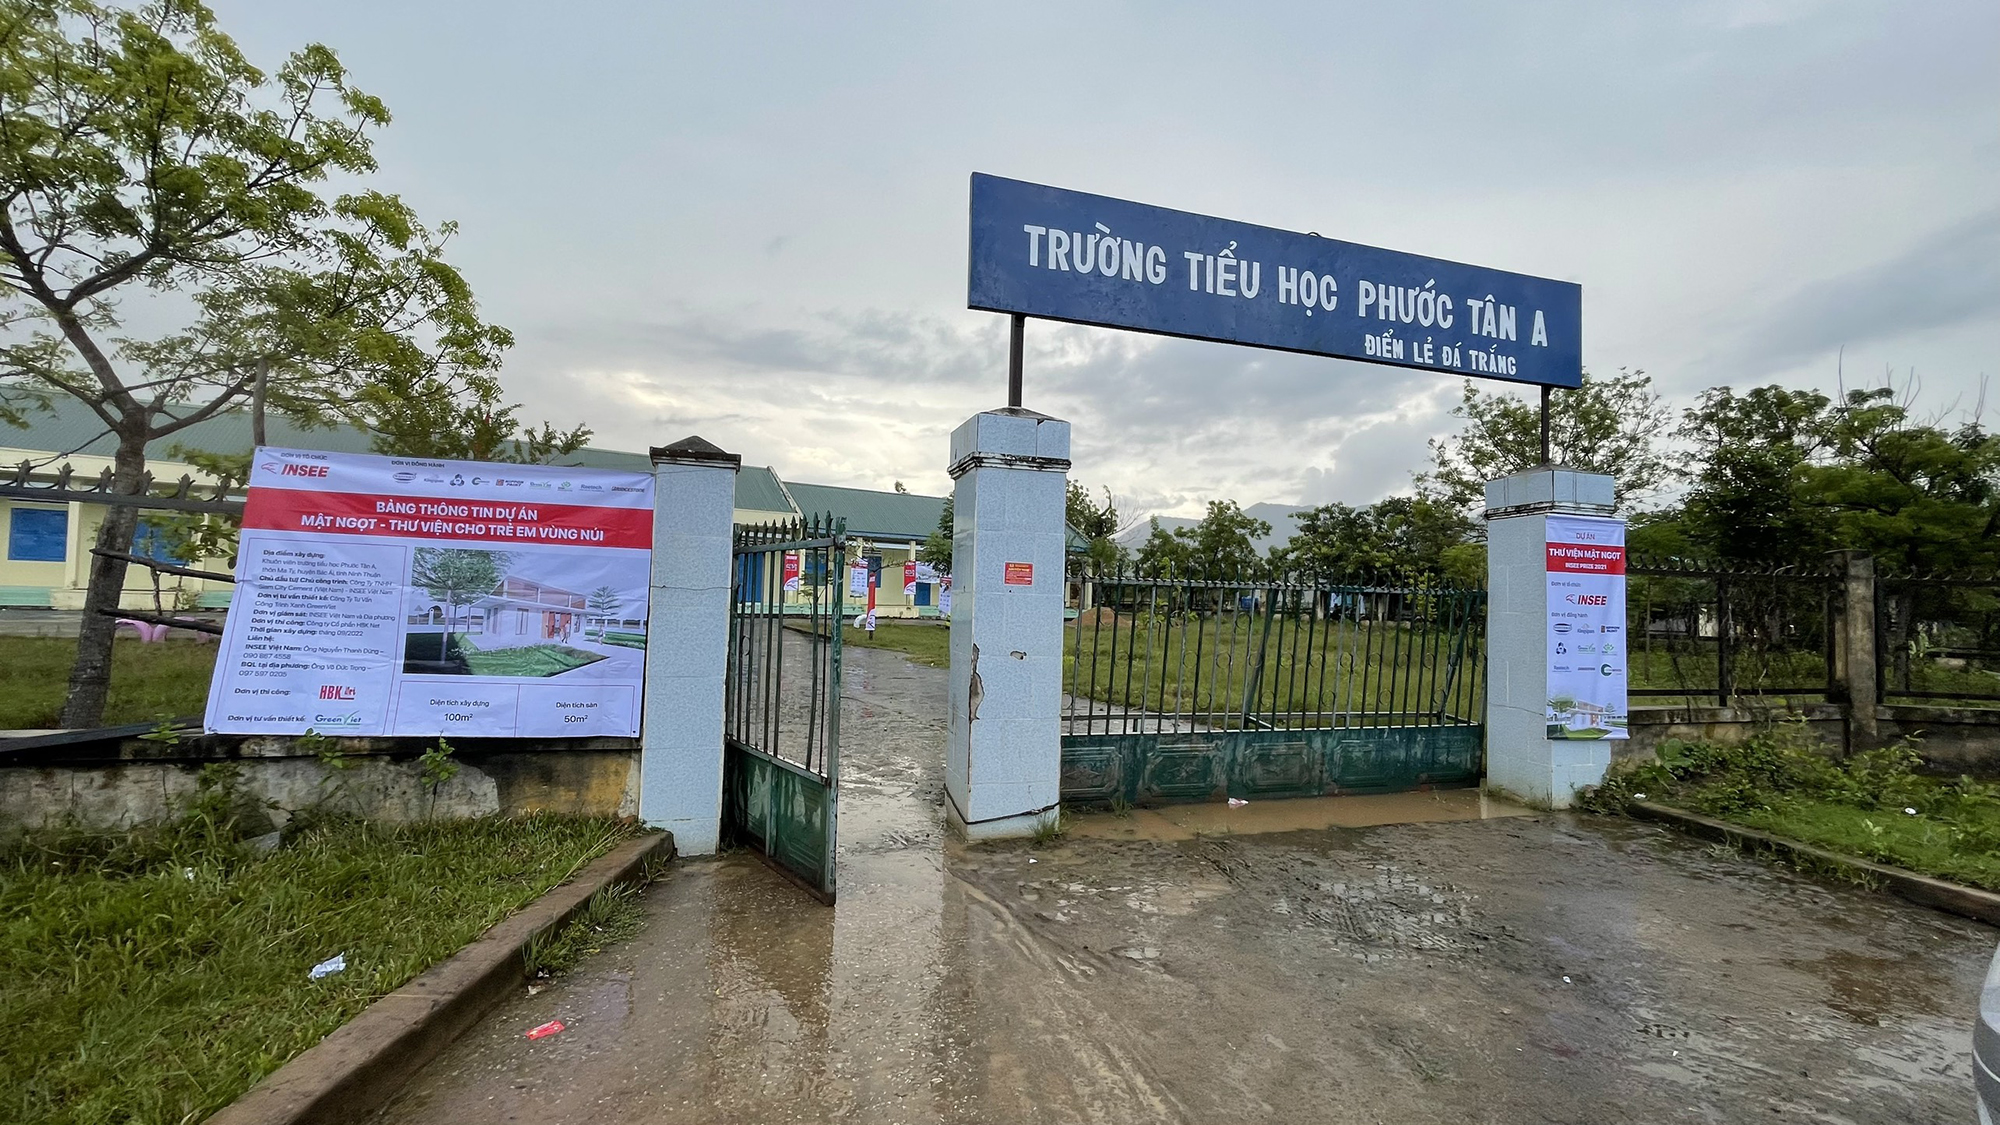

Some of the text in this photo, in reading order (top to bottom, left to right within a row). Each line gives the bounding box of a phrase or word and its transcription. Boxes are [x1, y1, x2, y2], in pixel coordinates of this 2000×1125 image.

[1024, 222, 1548, 347] TRƯỜNG TIỂU HỌC PHƯỚC TÂN A
[1364, 329, 1517, 375] ĐIỂM LẺ ĐÁ TRẮNG
[281, 464, 329, 477] INSEE
[376, 499, 538, 522] BẢNG THÔNG TIN DỰ ÁN
[301, 512, 604, 540] MẬT NGỌT THƯ VIỆN CHO TRẺ EM VÙNG NÚI
[1586, 532, 1595, 540] ÁN
[1549, 548, 1621, 560] THƯ VIỆN MẬT NGỌT
[1578, 595, 1608, 606] INSEE
[319, 686, 342, 700] HBK
[430, 698, 445, 707] Diện
[460, 700, 472, 708] xây
[472, 700, 490, 708] dựng
